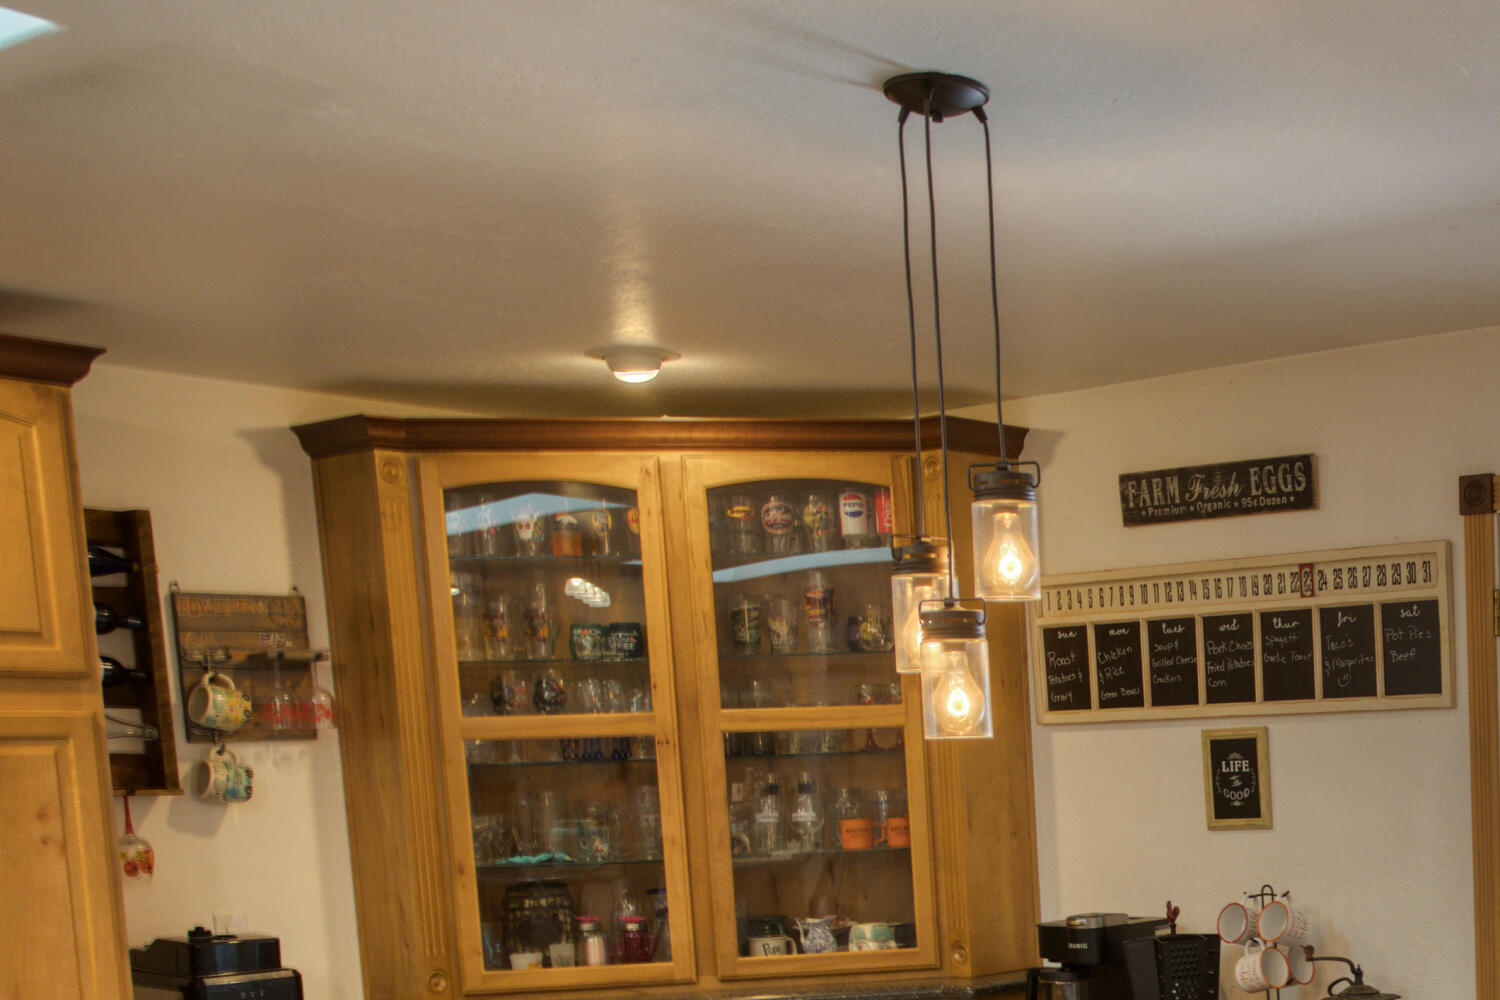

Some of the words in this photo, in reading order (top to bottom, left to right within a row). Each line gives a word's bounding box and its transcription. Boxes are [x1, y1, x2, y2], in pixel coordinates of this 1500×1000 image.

[1128, 475, 1180, 508] FARM
[1185, 472, 1243, 502] Fresh
[1249, 461, 1307, 496] EGGS
[1148, 505, 1186, 518] Premium
[1196, 500, 1231, 513] Organic
[1259, 495, 1288, 507] Dozen
[1140, 583, 1149, 605] 10
[1153, 583, 1160, 604] 11
[1164, 581, 1173, 603] 12
[1176, 580, 1185, 602] 13
[1189, 579, 1197, 601] 14
[1201, 578, 1210, 600] 15
[1214, 577, 1222, 599] 16
[1226, 576, 1234, 598] 17
[1238, 575, 1247, 597] 18
[1251, 574, 1259, 596] 19
[1263, 573, 1273, 595] 20
[1277, 572, 1286, 594] 21
[1290, 571, 1300, 593] 22
[1303, 570, 1313, 592] 23
[1317, 569, 1328, 591] 24
[1333, 568, 1343, 590] 25
[1348, 566, 1358, 589] 26
[1362, 565, 1371, 588] 27
[1377, 564, 1386, 586] 28
[1391, 563, 1401, 585] 29
[1406, 561, 1417, 584] 30
[1422, 560, 1432, 583] 31
[1400, 604, 1421, 618] sat
[1272, 616, 1301, 629] thur
[1337, 611, 1358, 628] fri
[1161, 622, 1185, 634] tues
[1384, 628, 1405, 642] Pot
[1408, 625, 1432, 640] Pies
[1206, 640, 1228, 655] Pork
[1229, 640, 1254, 652] Chops
[1048, 651, 1077, 669] Roast
[1097, 646, 1133, 664] Chicken
[1264, 651, 1287, 664] Garlic
[1389, 648, 1416, 663] Beef
[1152, 656, 1174, 669] Grilled
[1206, 660, 1225, 674] Fried
[1104, 666, 1125, 680] Rice
[1207, 678, 1227, 688] Corn
[1222, 760, 1249, 773] LIFE
[1223, 788, 1250, 800] GOOD
